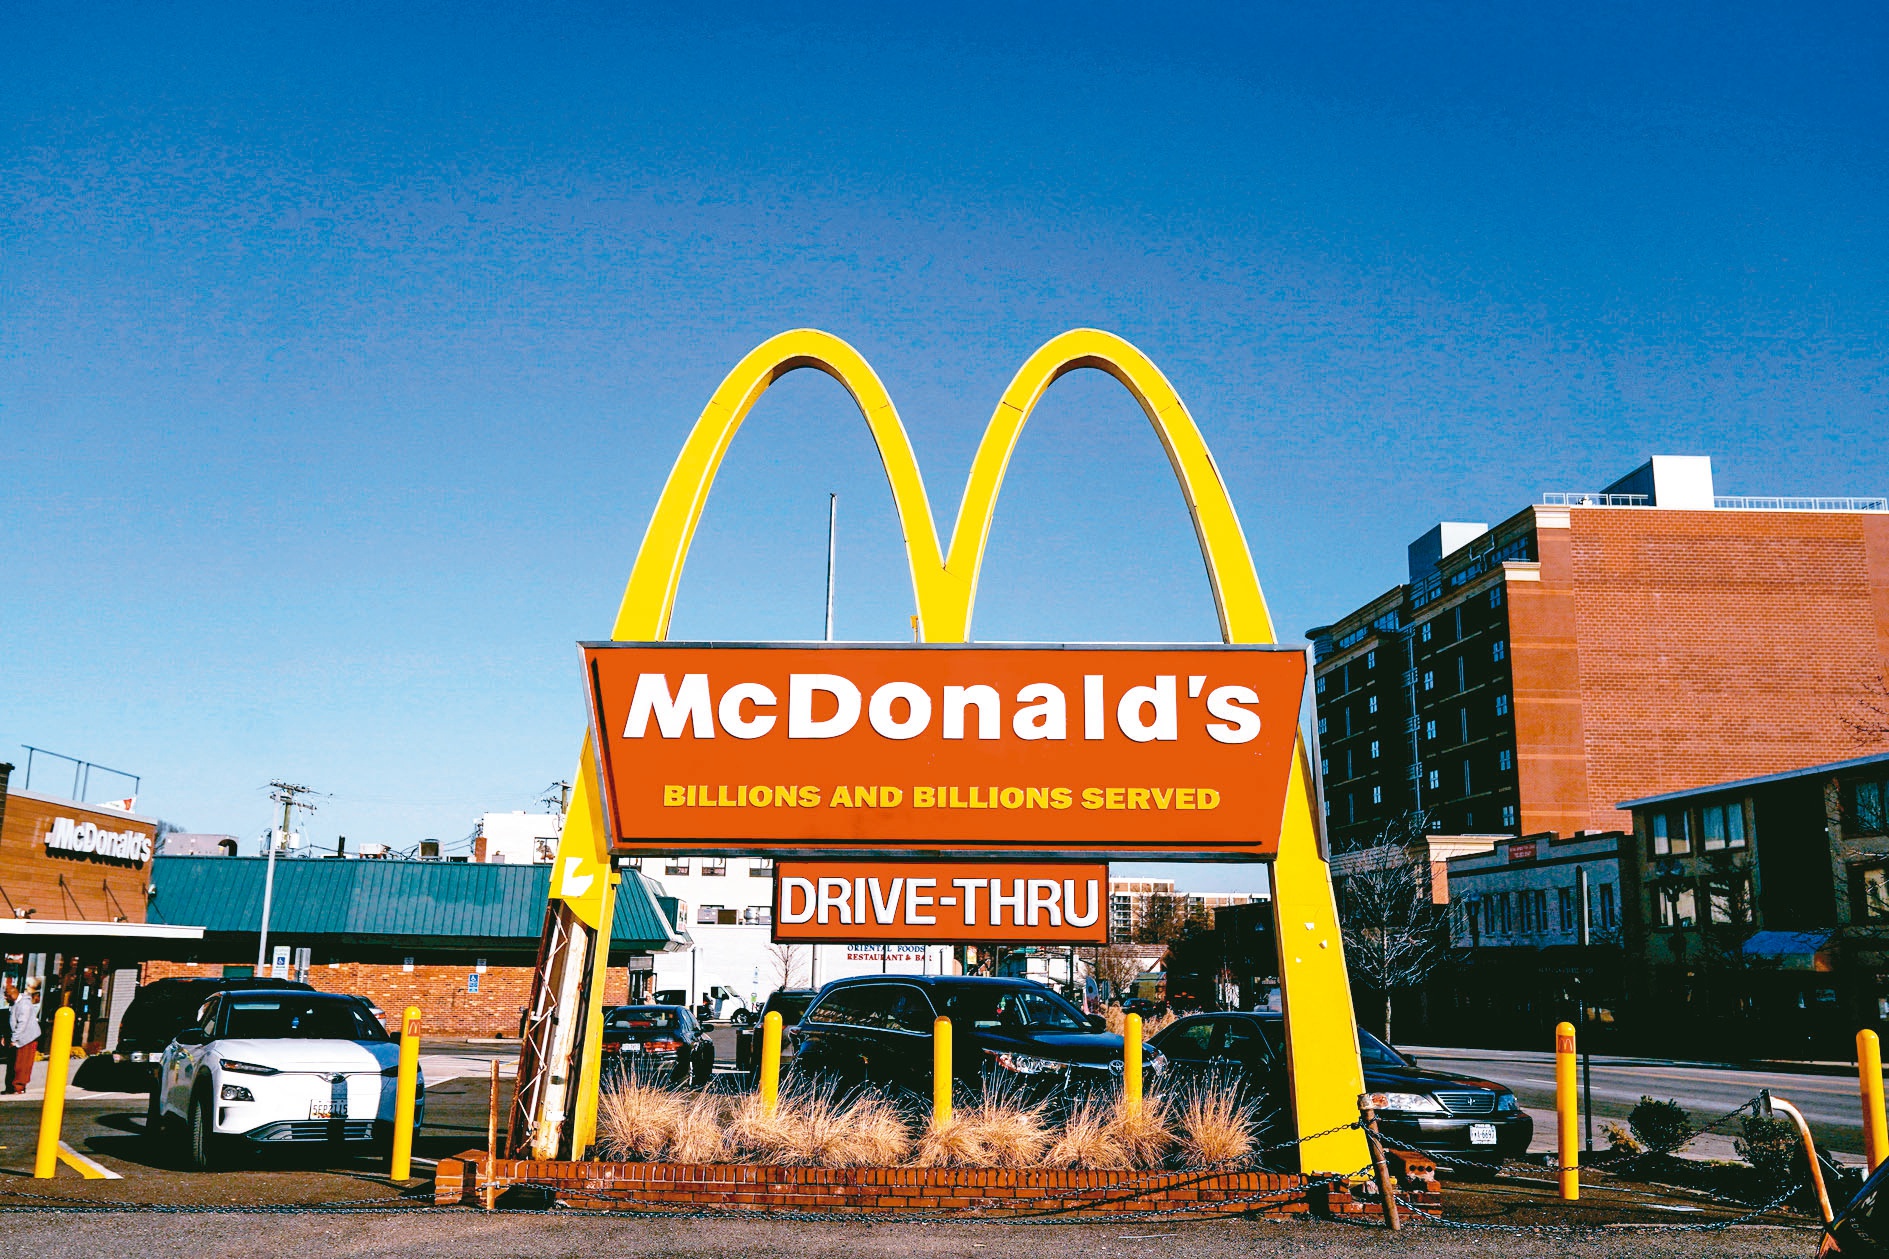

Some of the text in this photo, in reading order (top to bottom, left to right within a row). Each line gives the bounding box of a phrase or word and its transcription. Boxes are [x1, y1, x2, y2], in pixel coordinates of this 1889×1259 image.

[623, 673, 1261, 744] McDonald's
[663, 784, 1221, 811] BILLIONS AND BILLIONS SERVED
[48, 817, 152, 863] McDonald's
[780, 877, 1100, 927] DRIVE-THRU
